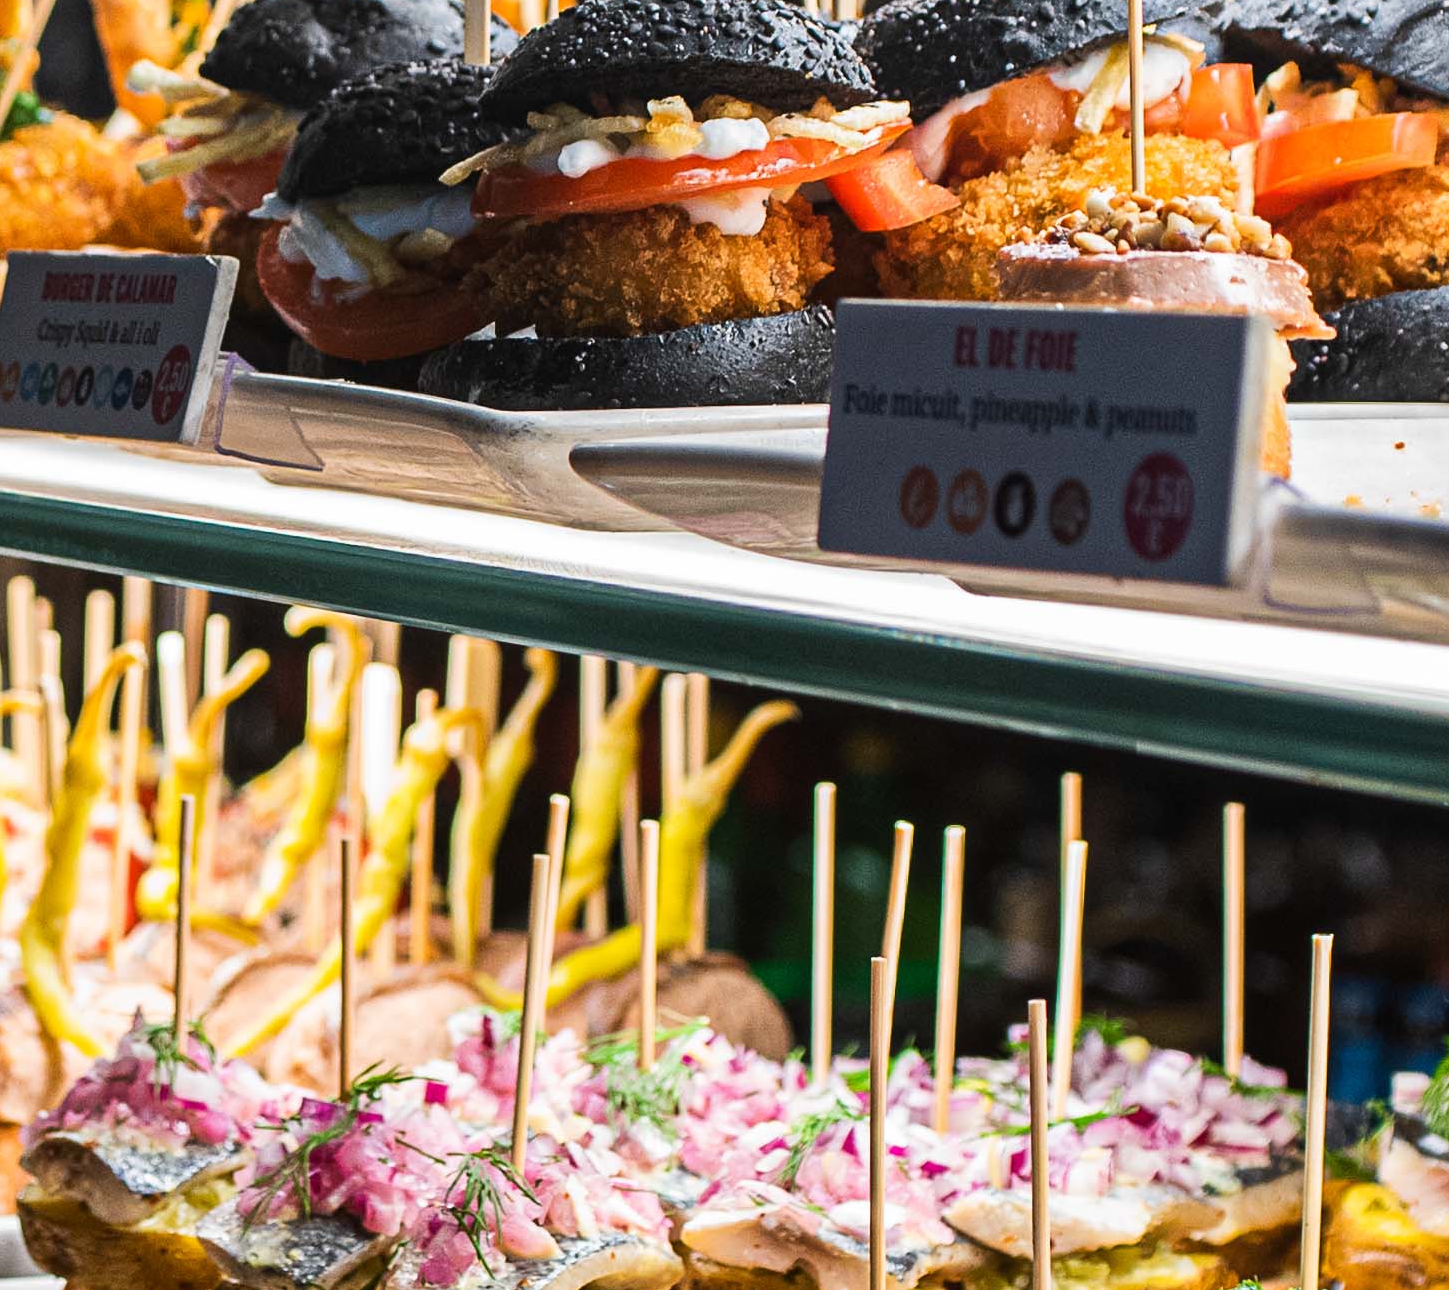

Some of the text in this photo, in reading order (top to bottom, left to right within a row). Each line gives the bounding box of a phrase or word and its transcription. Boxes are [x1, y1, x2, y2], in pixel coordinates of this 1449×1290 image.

[41, 272, 178, 304] BURGER DE CALAMAR
[37, 318, 75, 348] Crispy
[75, 319, 110, 348] Squid
[109, 322, 119, 344] &
[953, 325, 1079, 374] EL DE FOIE
[158, 360, 191, 393] 2,50
[842, 383, 1199, 441] Foie micuit, pineapple & peanuts
